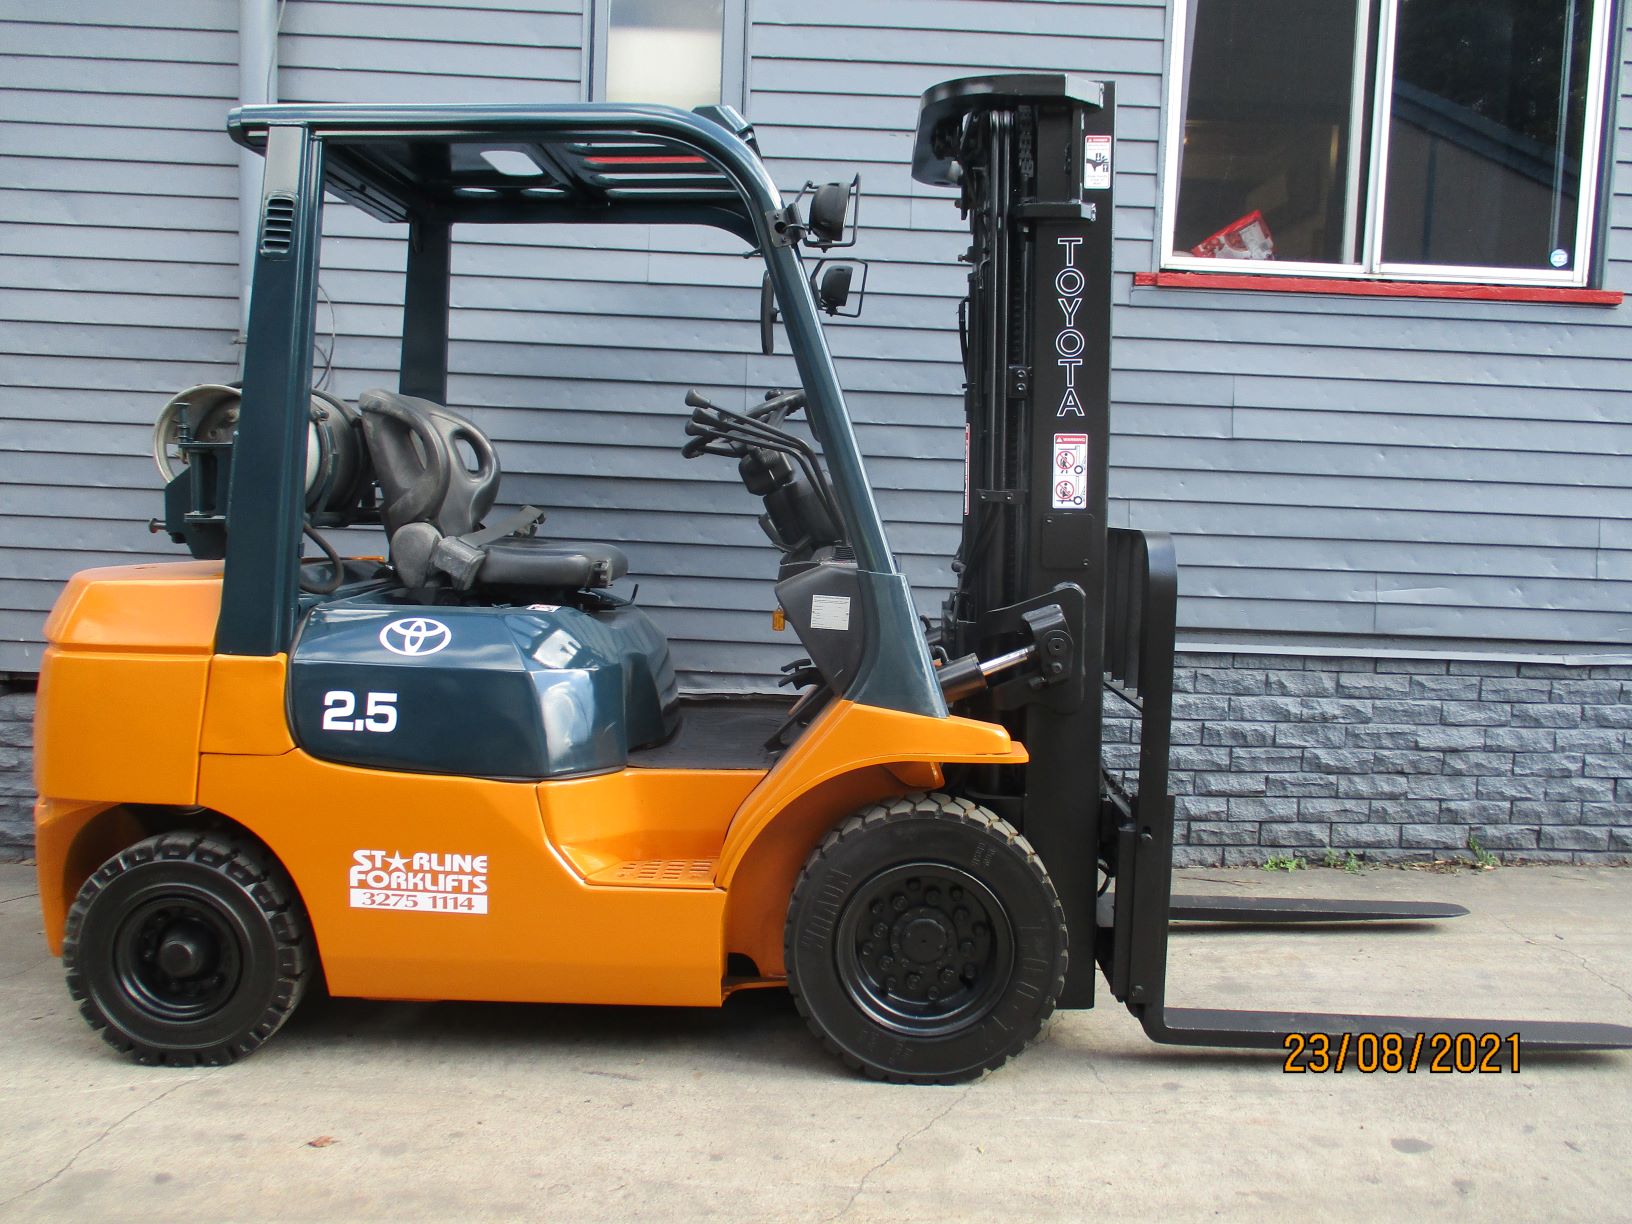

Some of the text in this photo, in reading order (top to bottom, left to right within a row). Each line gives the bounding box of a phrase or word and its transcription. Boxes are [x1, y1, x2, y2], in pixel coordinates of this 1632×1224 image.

[1055, 236, 1086, 417] TOYOTA
[323, 690, 398, 733] 2.5
[349, 865, 488, 894] FORKLIFTS
[362, 891, 475, 911] 3275 1114
